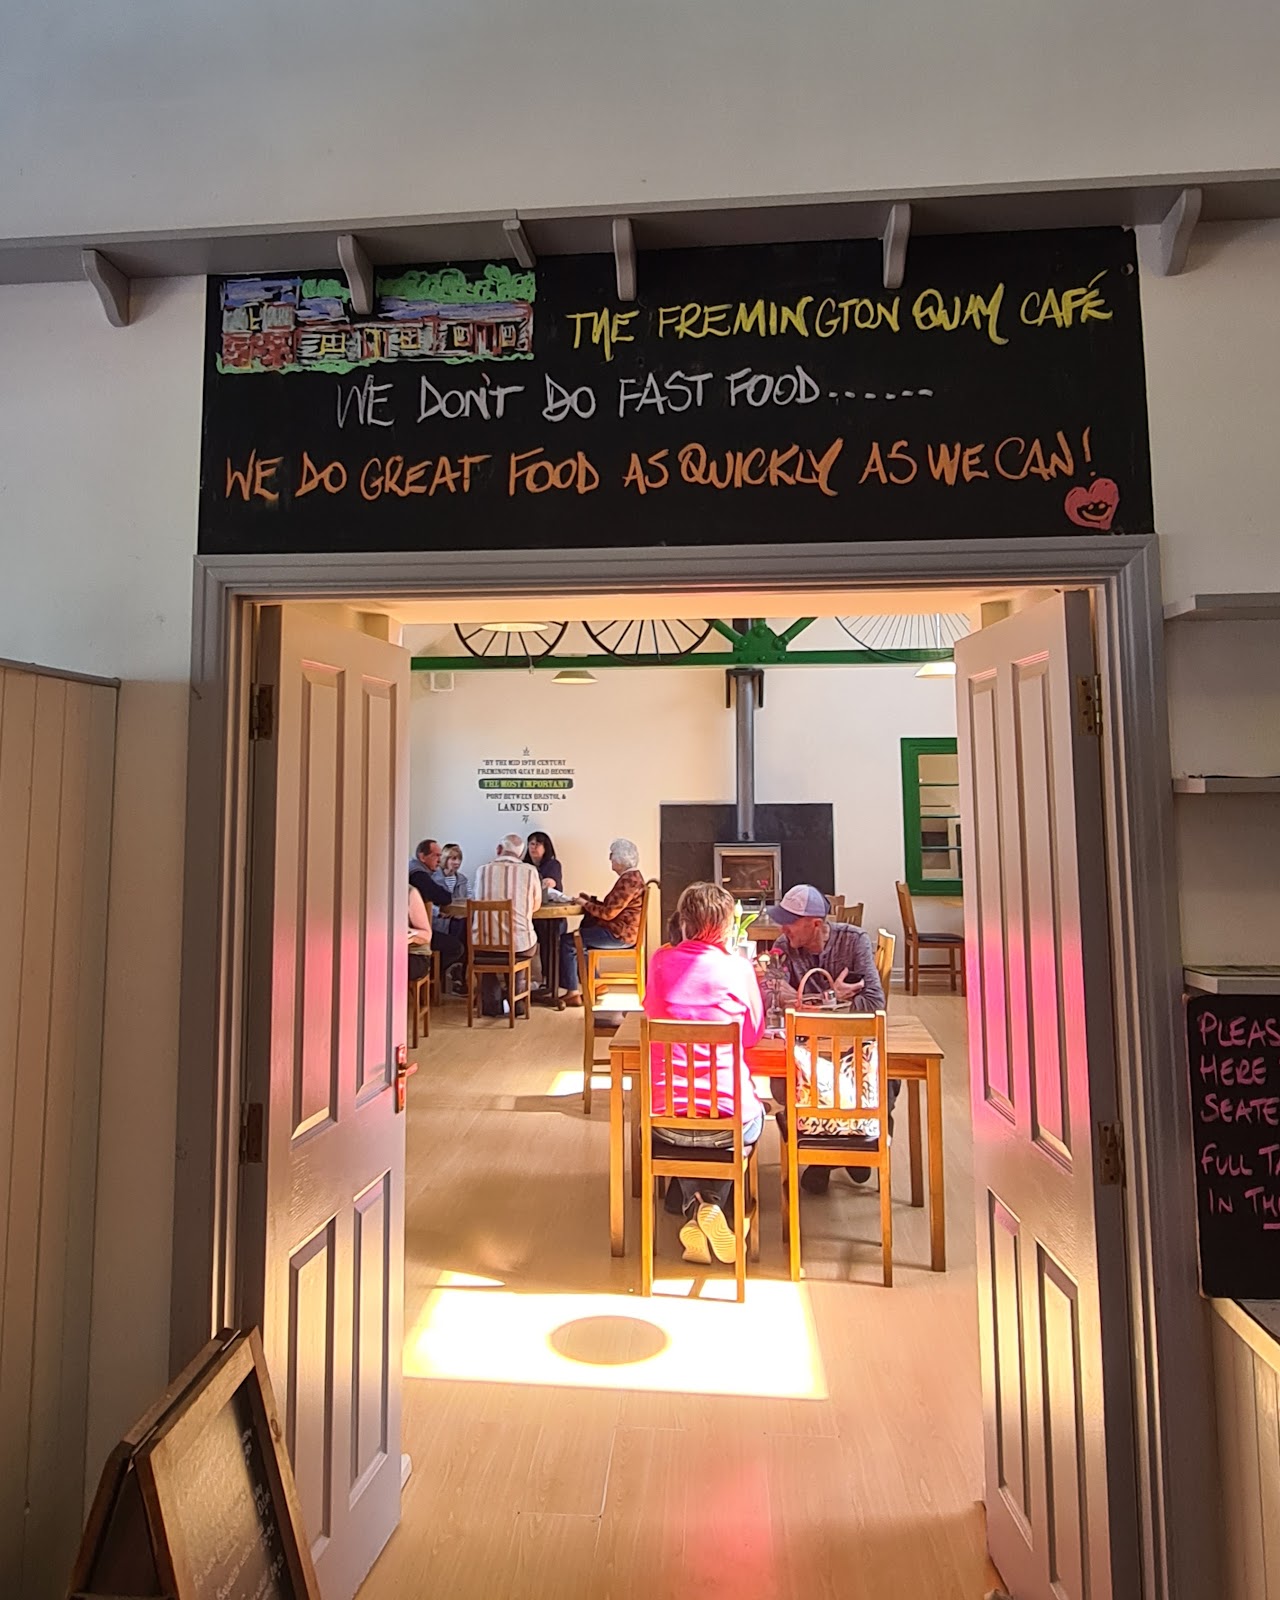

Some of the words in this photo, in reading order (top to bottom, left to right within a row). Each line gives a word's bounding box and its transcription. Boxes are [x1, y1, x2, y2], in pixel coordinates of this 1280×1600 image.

[658, 296, 900, 339] FREMINGTON
[912, 282, 1009, 345] QUAY
[1020, 269, 1113, 328] CAFÉ
[337, 374, 394, 428] WE
[417, 372, 525, 423] DON'T
[542, 373, 596, 422] DO
[619, 370, 713, 418] FAST
[225, 449, 284, 501] WE
[295, 451, 348, 498] DO
[360, 454, 492, 500] GREAT
[509, 447, 600, 496] FOOD
[622, 449, 669, 495] AS
[678, 438, 844, 497] QUICKLY
[858, 440, 918, 485] AS
[927, 442, 989, 486] WE
[995, 426, 1098, 481] CAN!
[483, 780, 499, 788] THE
[500, 780, 522, 788] MOST
[523, 780, 569, 788] IMPORTANT
[497, 803, 530, 811] LAND'S
[1200, 1054, 1266, 1086] HERE
[1201, 1143, 1253, 1176] FULL
[1209, 1188, 1233, 1216] IN
[1244, 1186, 1280, 1217] TH
